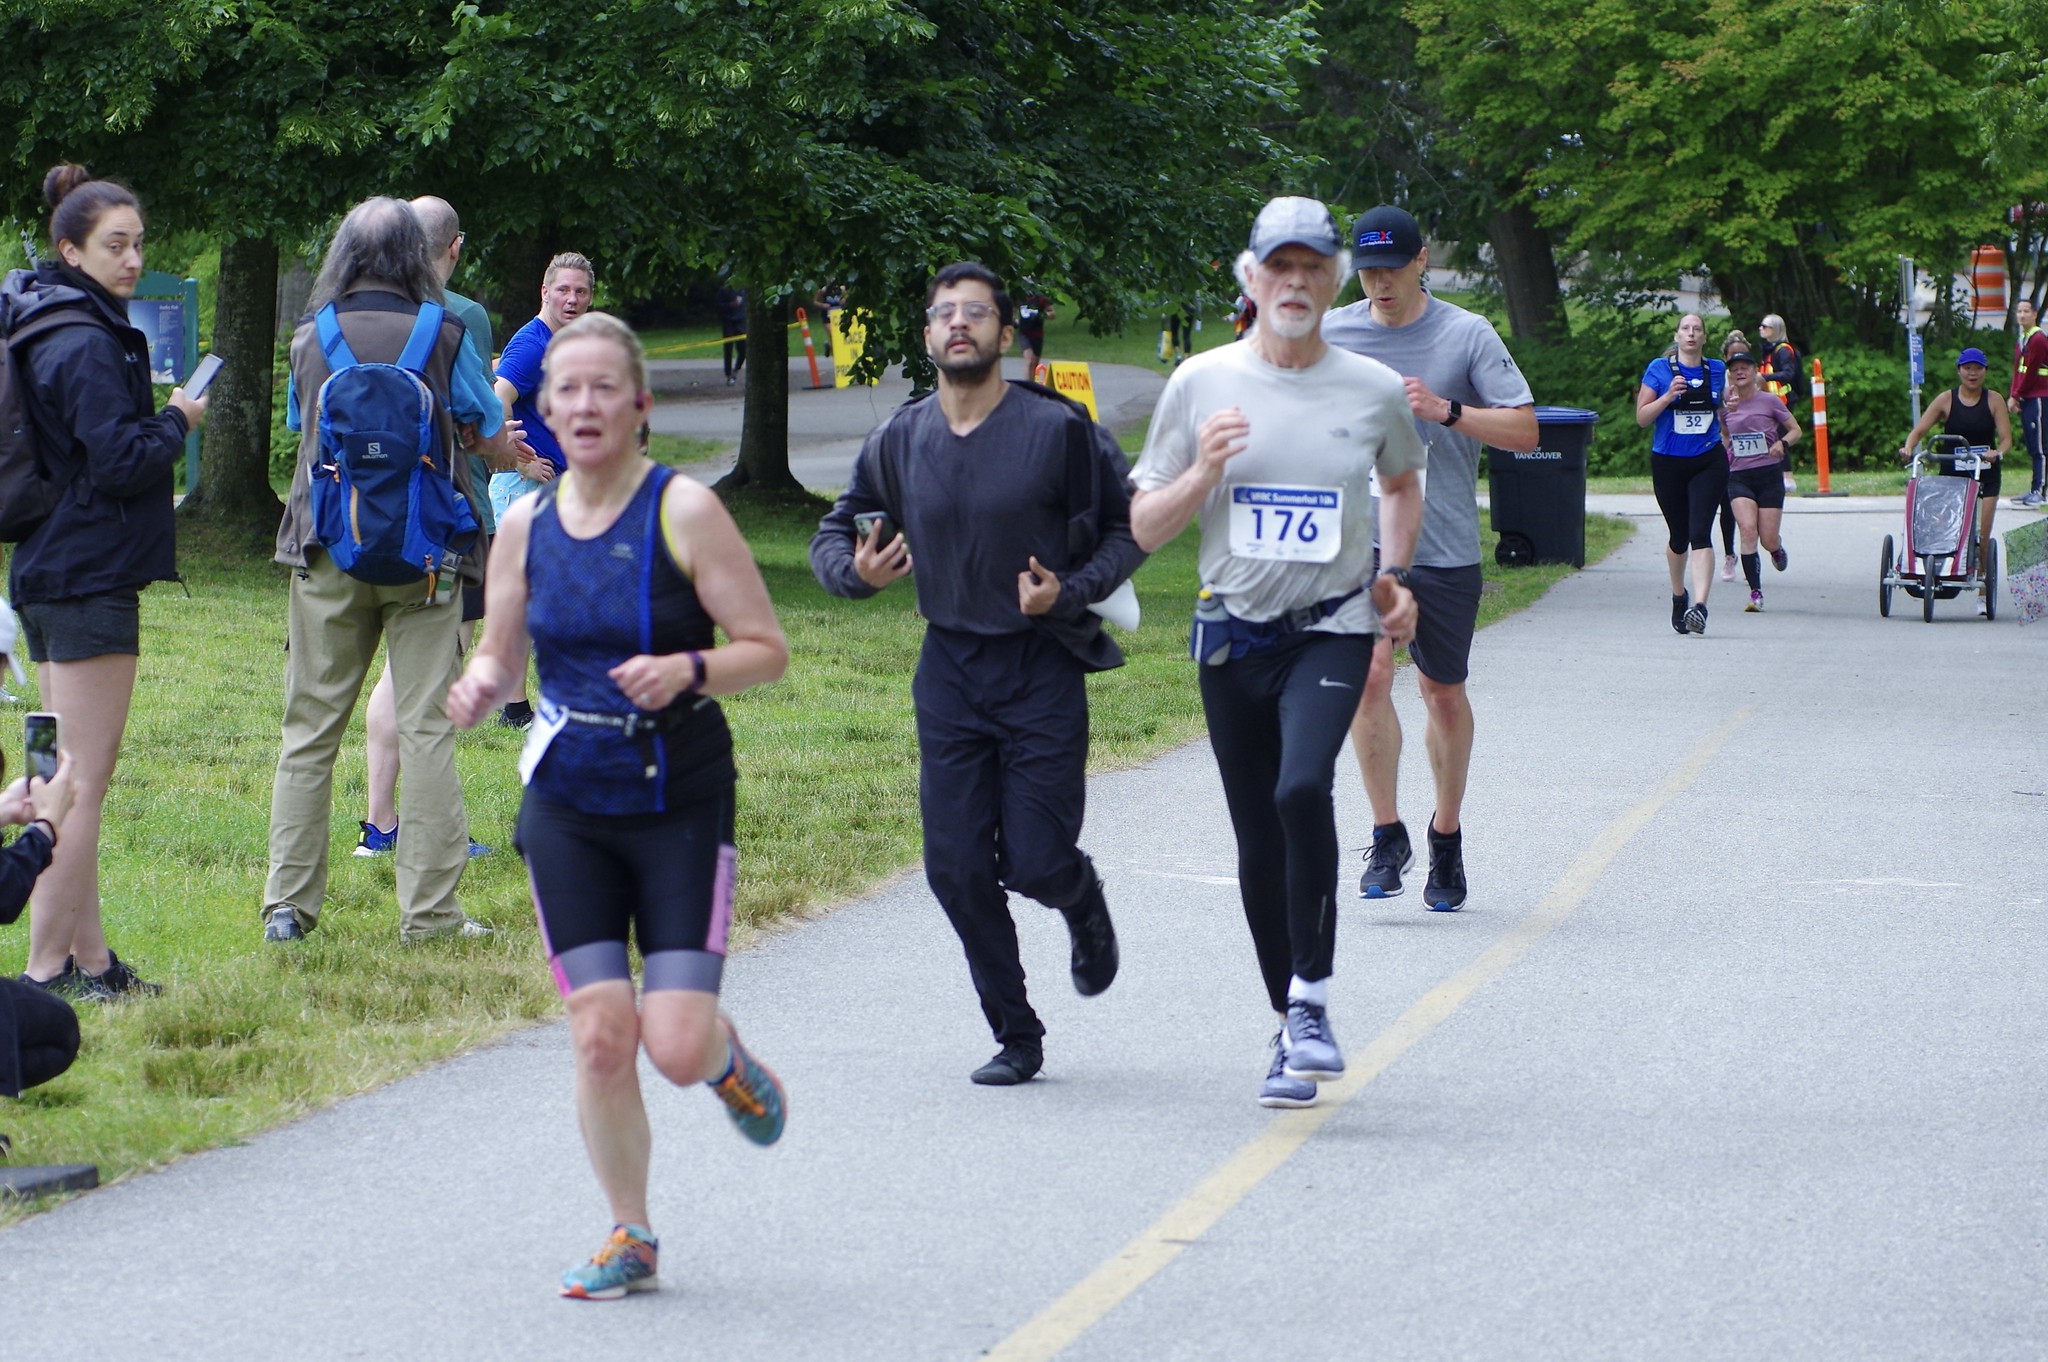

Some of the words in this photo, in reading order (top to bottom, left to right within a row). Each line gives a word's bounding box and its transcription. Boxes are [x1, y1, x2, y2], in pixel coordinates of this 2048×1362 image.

[1056, 369, 1091, 391] CAUTION
[1685, 415, 1703, 428] 32
[1738, 440, 1759, 451] 371
[1514, 451, 1562, 460] VANCOUVER
[1252, 508, 1318, 542] 176
